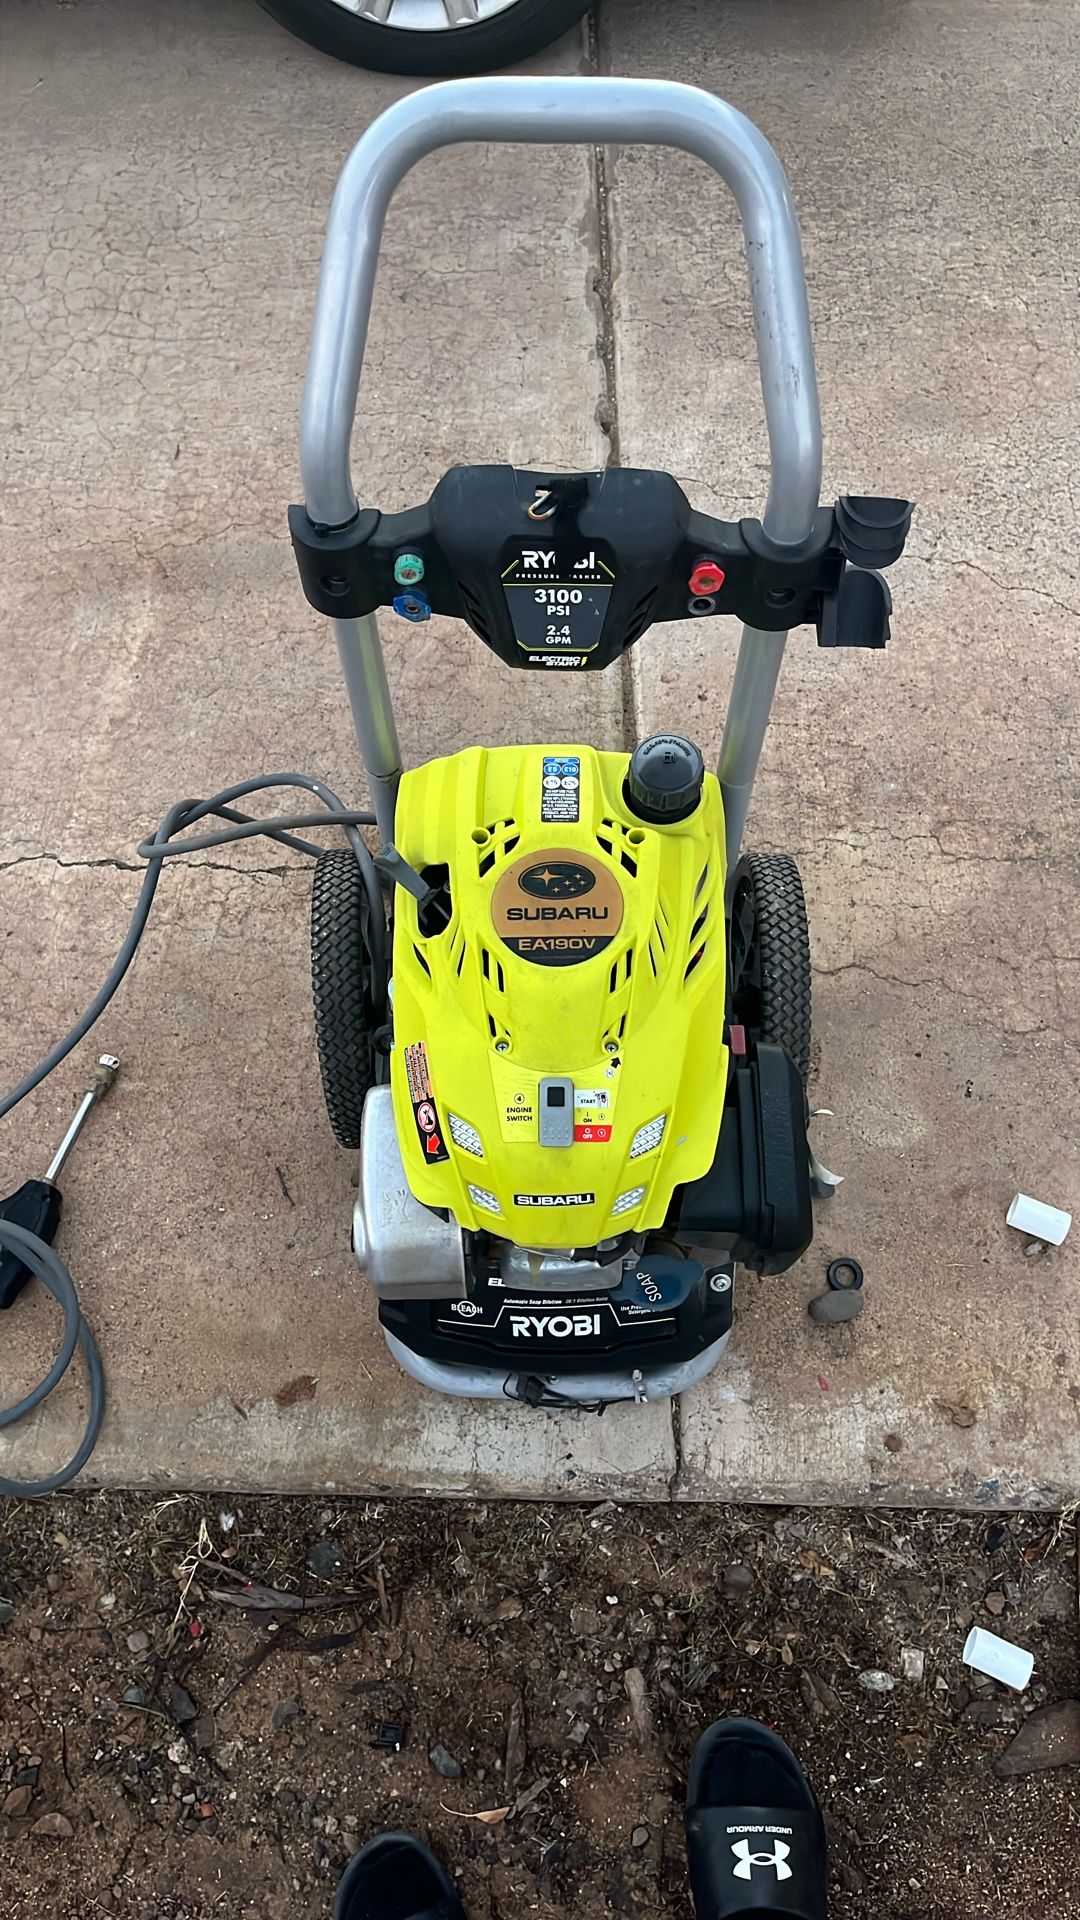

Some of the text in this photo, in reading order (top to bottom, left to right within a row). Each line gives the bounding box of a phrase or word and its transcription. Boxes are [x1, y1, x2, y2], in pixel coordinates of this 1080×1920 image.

[522, 550, 595, 569] RYI
[534, 589, 583, 604] 3100
[546, 605, 570, 616] PSI
[546, 625, 571, 636] 2.4
[545, 636, 572, 645] GPM
[506, 907, 609, 921] SUBARU
[518, 938, 597, 951] EA190V
[516, 1195, 592, 1205] SUBARU
[636, 1272, 662, 1302] SOAP
[510, 1315, 600, 1337] RYOBI
[726, 1825, 793, 1835] UNDER ARMOUR
